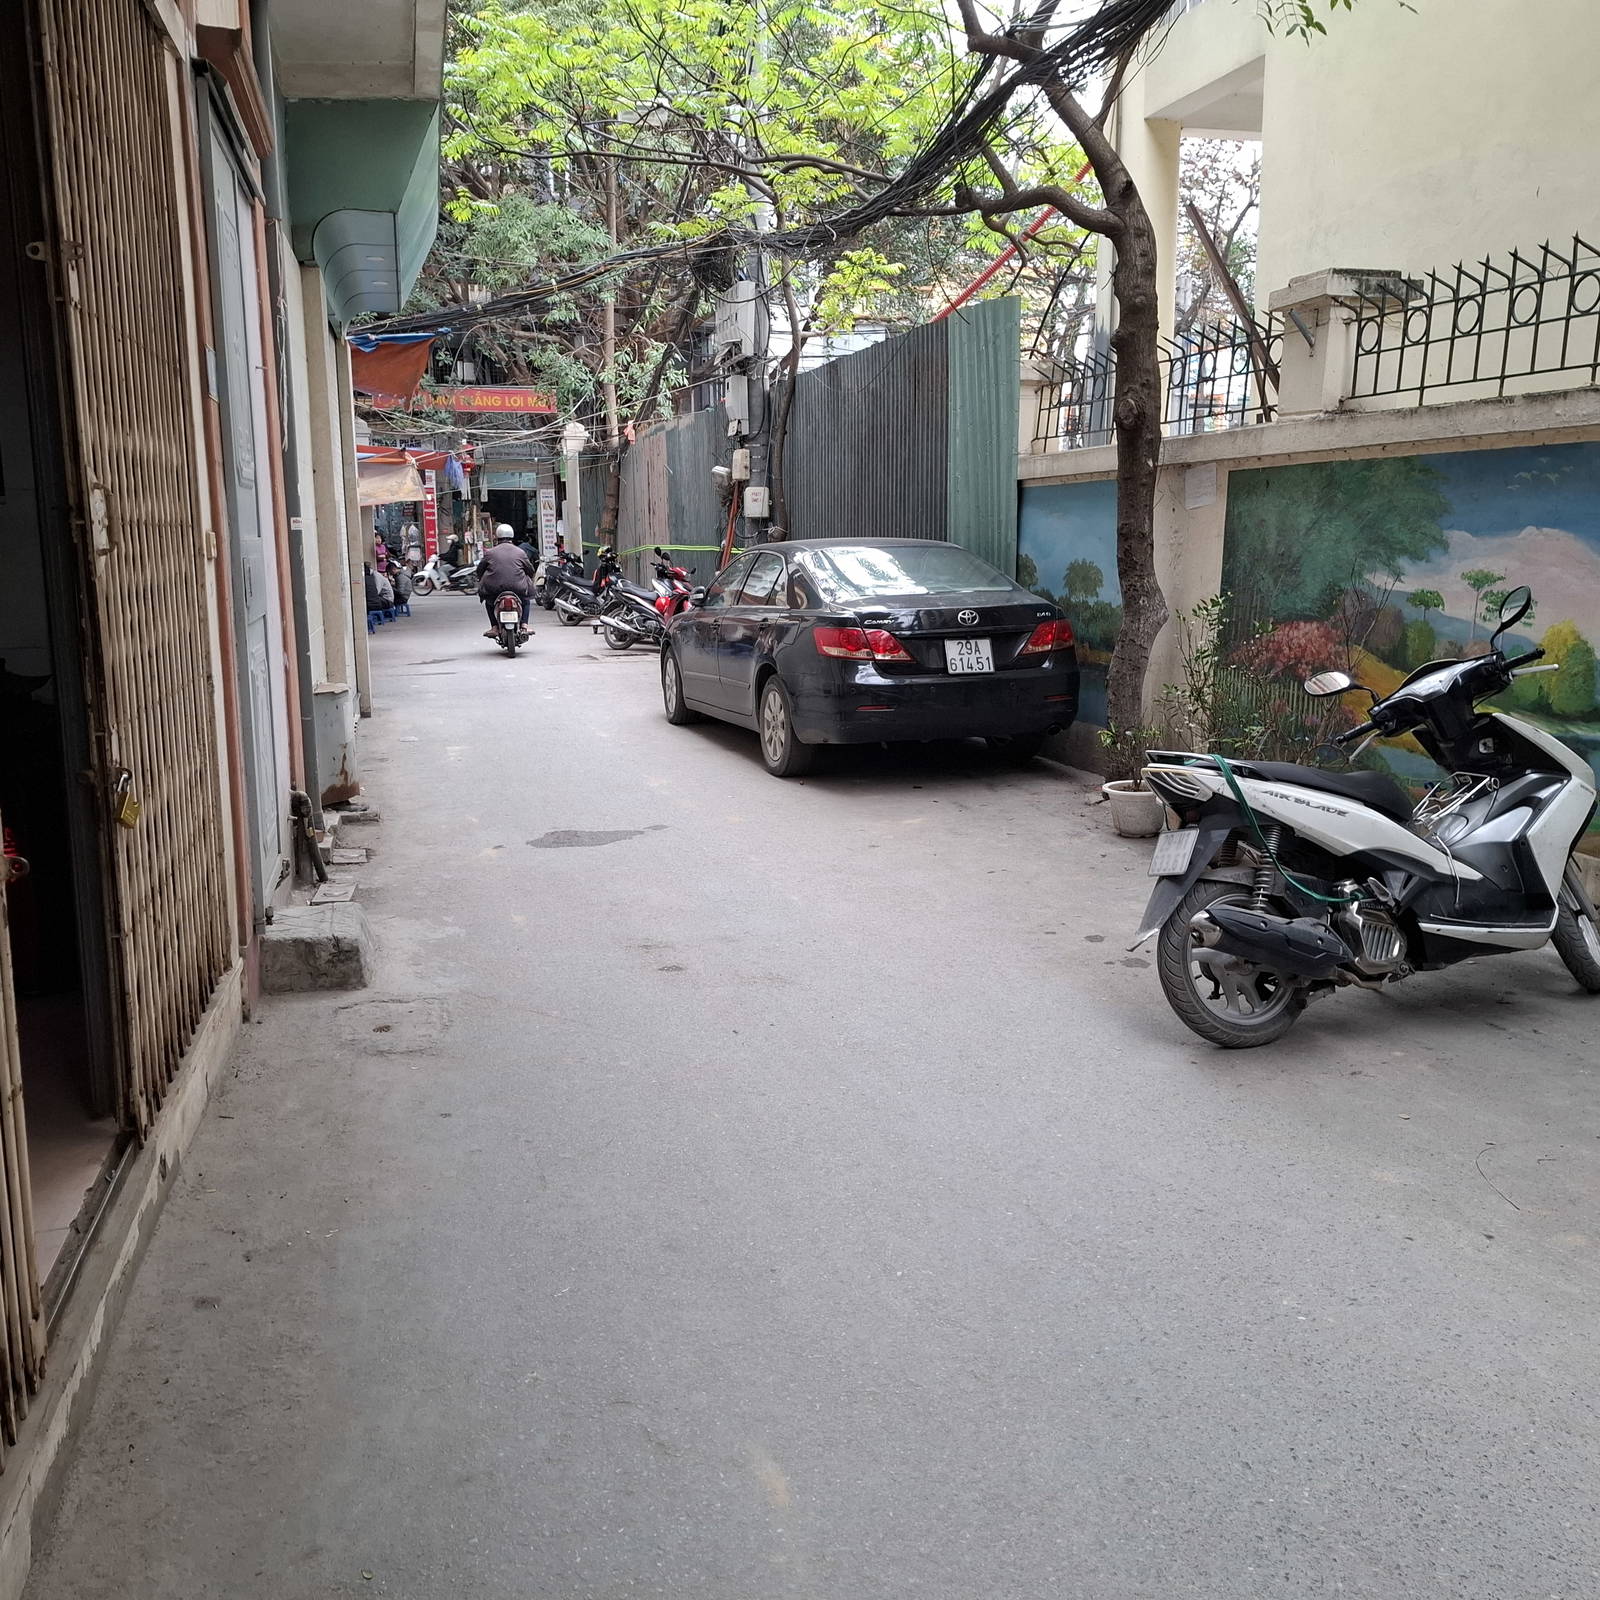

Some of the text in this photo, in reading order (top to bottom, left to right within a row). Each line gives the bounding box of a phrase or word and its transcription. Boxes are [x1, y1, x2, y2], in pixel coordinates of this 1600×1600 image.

[957, 640, 981, 655] 29A
[950, 656, 991, 671] 614.51
[1261, 790, 1349, 817] AIR BLADE
